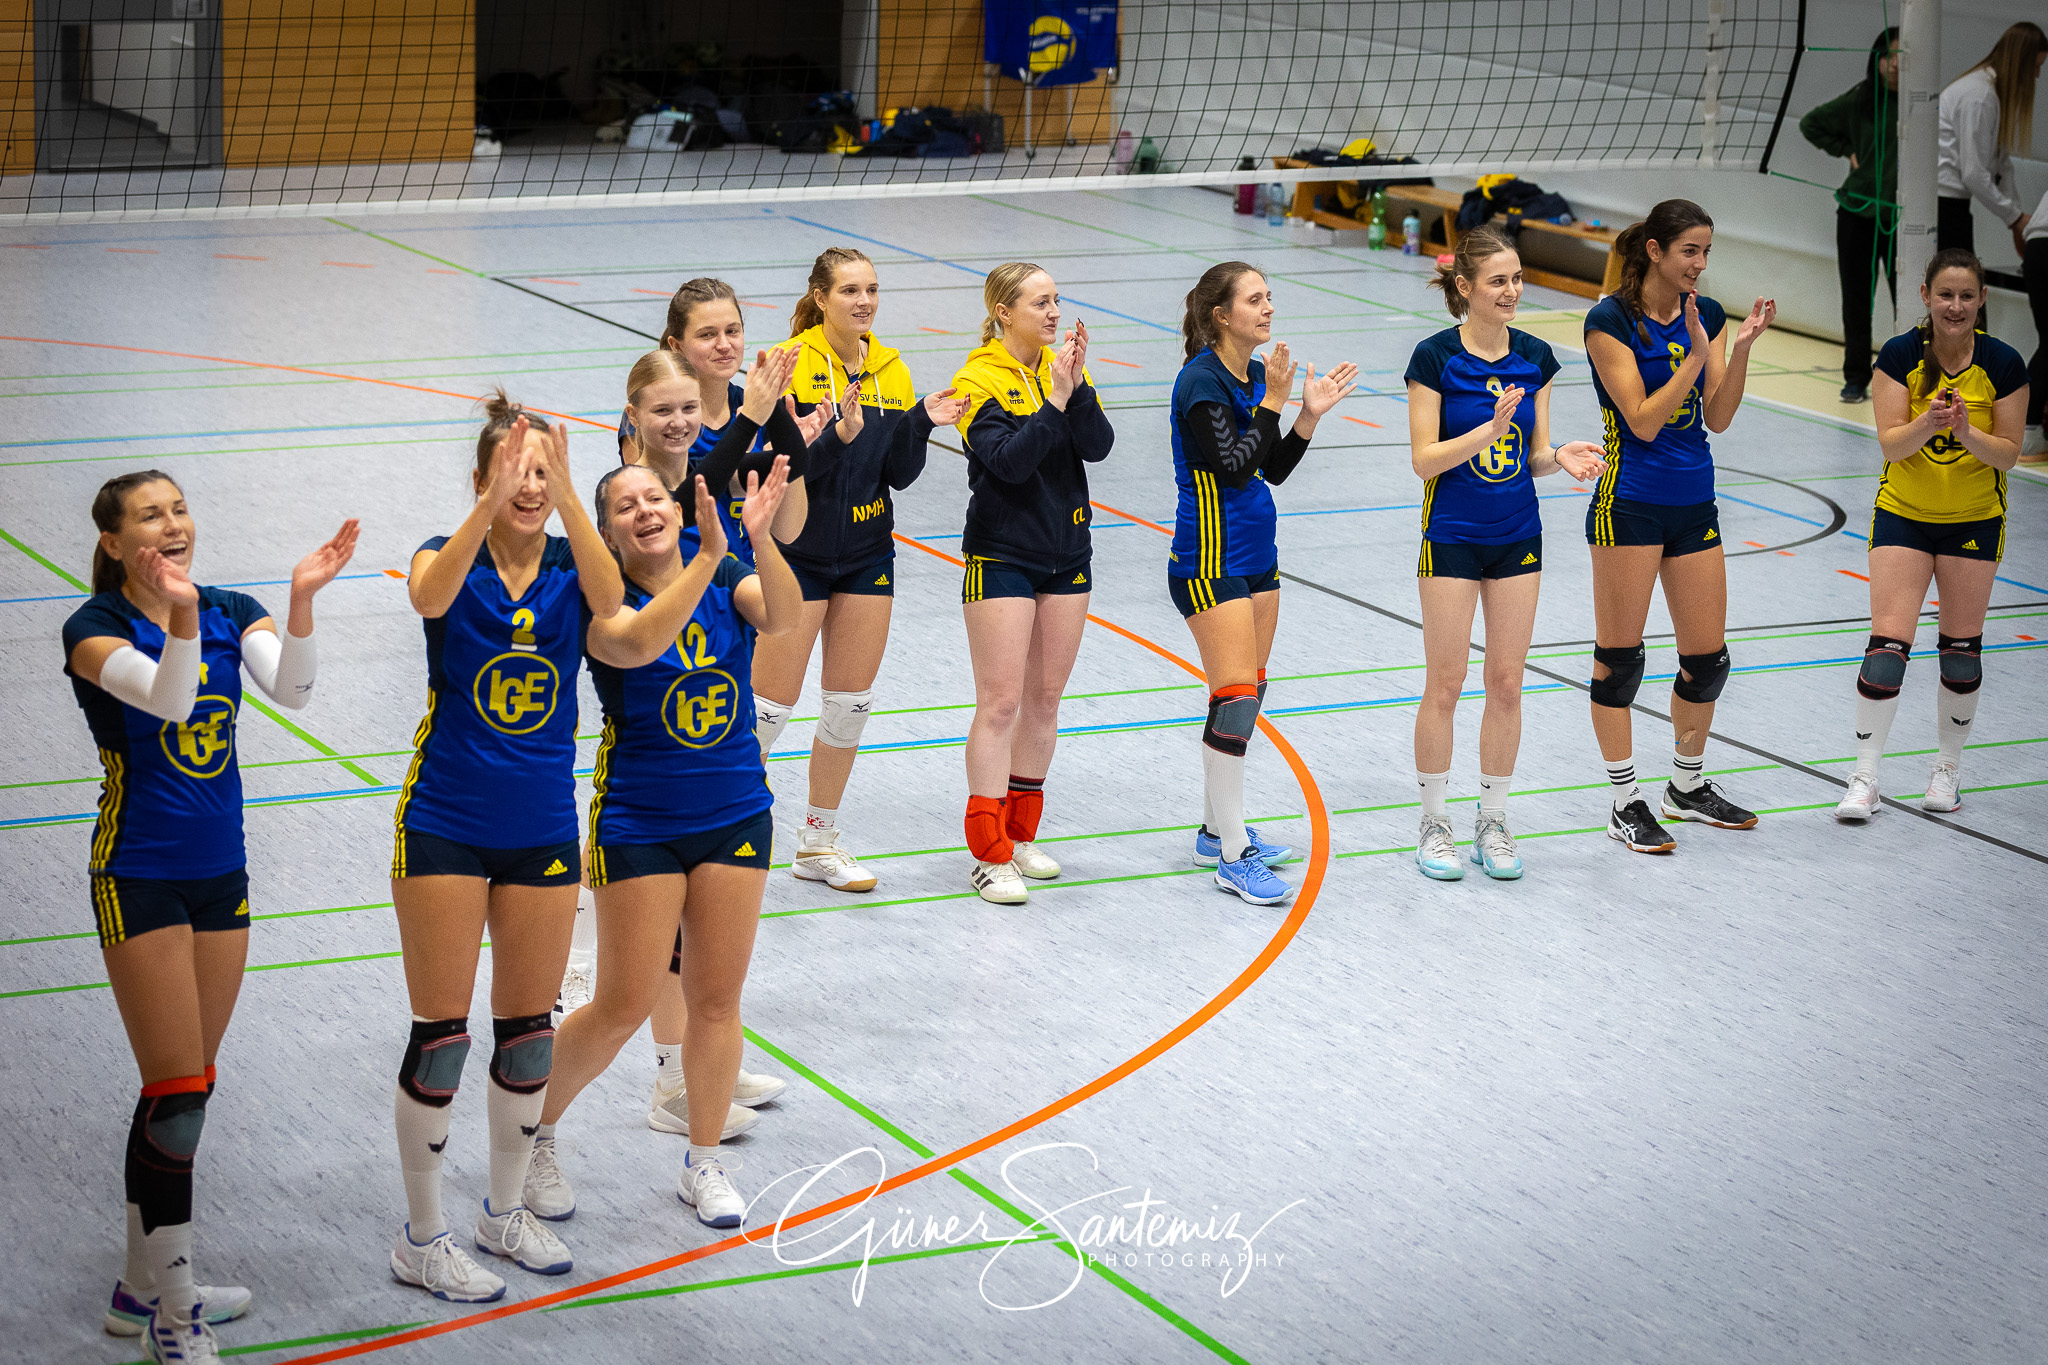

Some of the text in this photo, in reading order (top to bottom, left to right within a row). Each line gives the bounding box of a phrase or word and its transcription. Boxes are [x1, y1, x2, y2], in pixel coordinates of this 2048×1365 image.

[860, 394, 902, 406] SV Shwaig
[852, 498, 885, 523] NMH
[1073, 507, 1086, 525] CL
[511, 608, 536, 644] 2
[676, 622, 717, 670] 12
